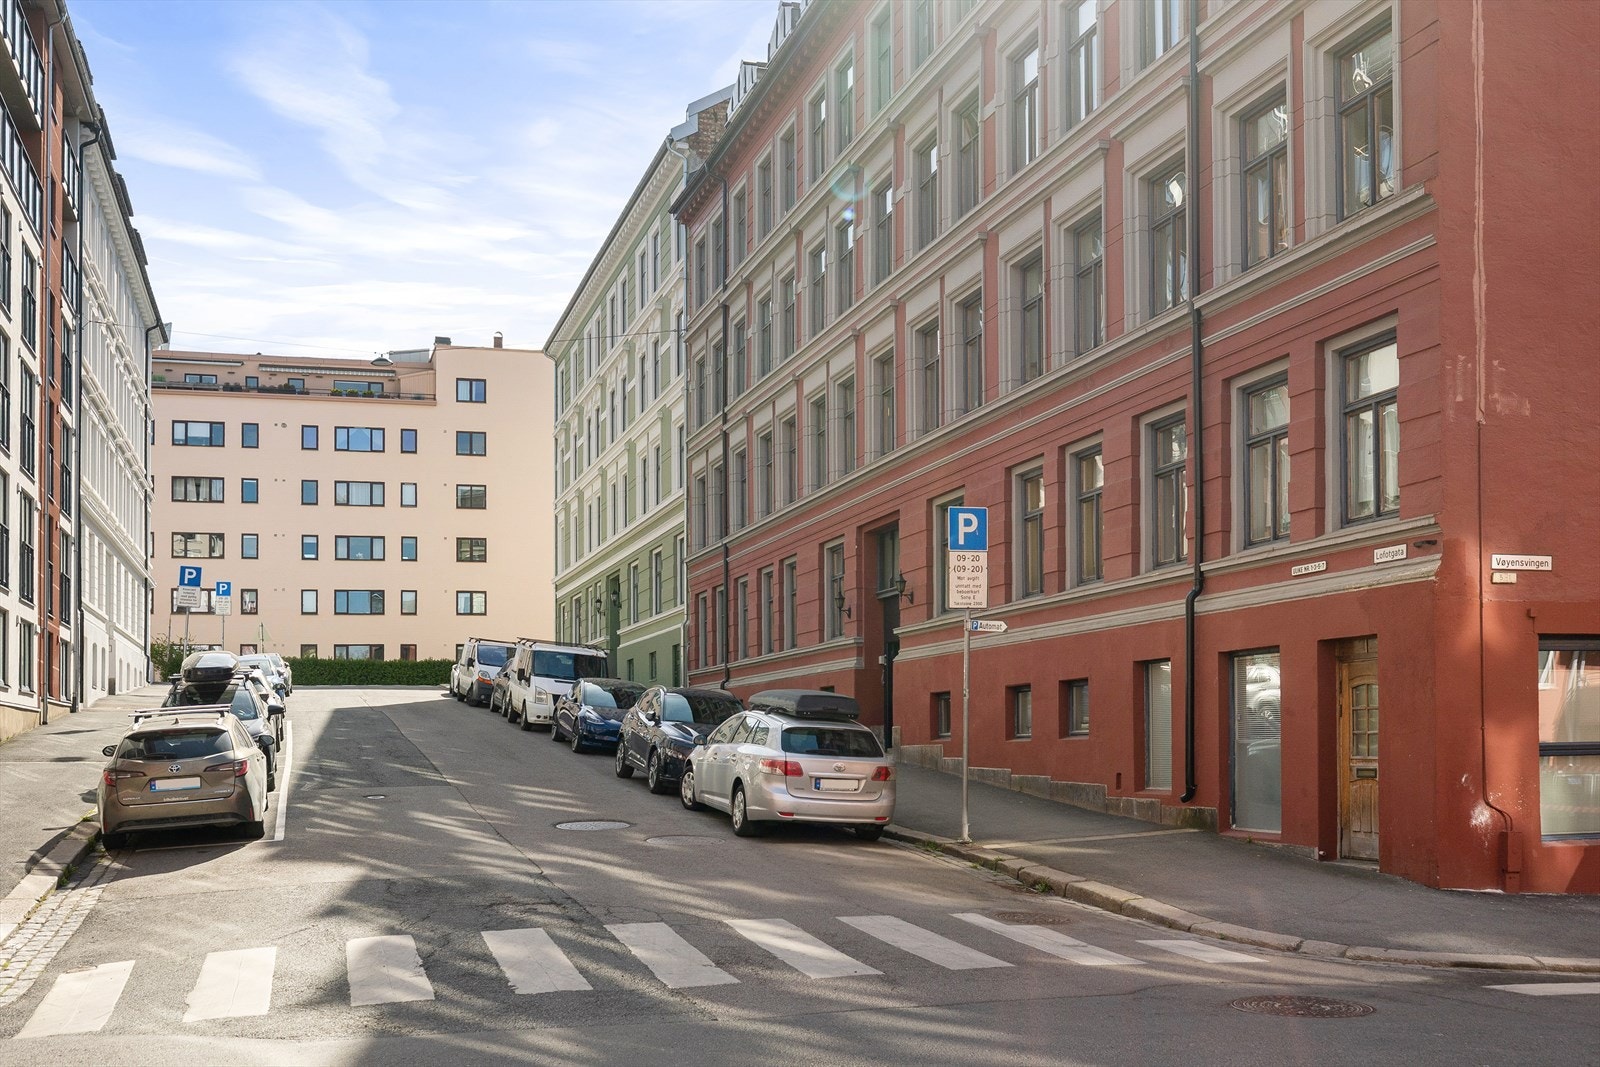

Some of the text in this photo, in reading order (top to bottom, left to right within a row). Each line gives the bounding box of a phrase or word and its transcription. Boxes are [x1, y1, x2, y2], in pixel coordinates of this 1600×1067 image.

[958, 513, 978, 545] P
[1375, 548, 1404, 559] Lofotgata
[1496, 558, 1549, 568] Vøyensvingen
[184, 569, 197, 584] P
[219, 583, 228, 595] P
[979, 622, 1002, 630] Automat
